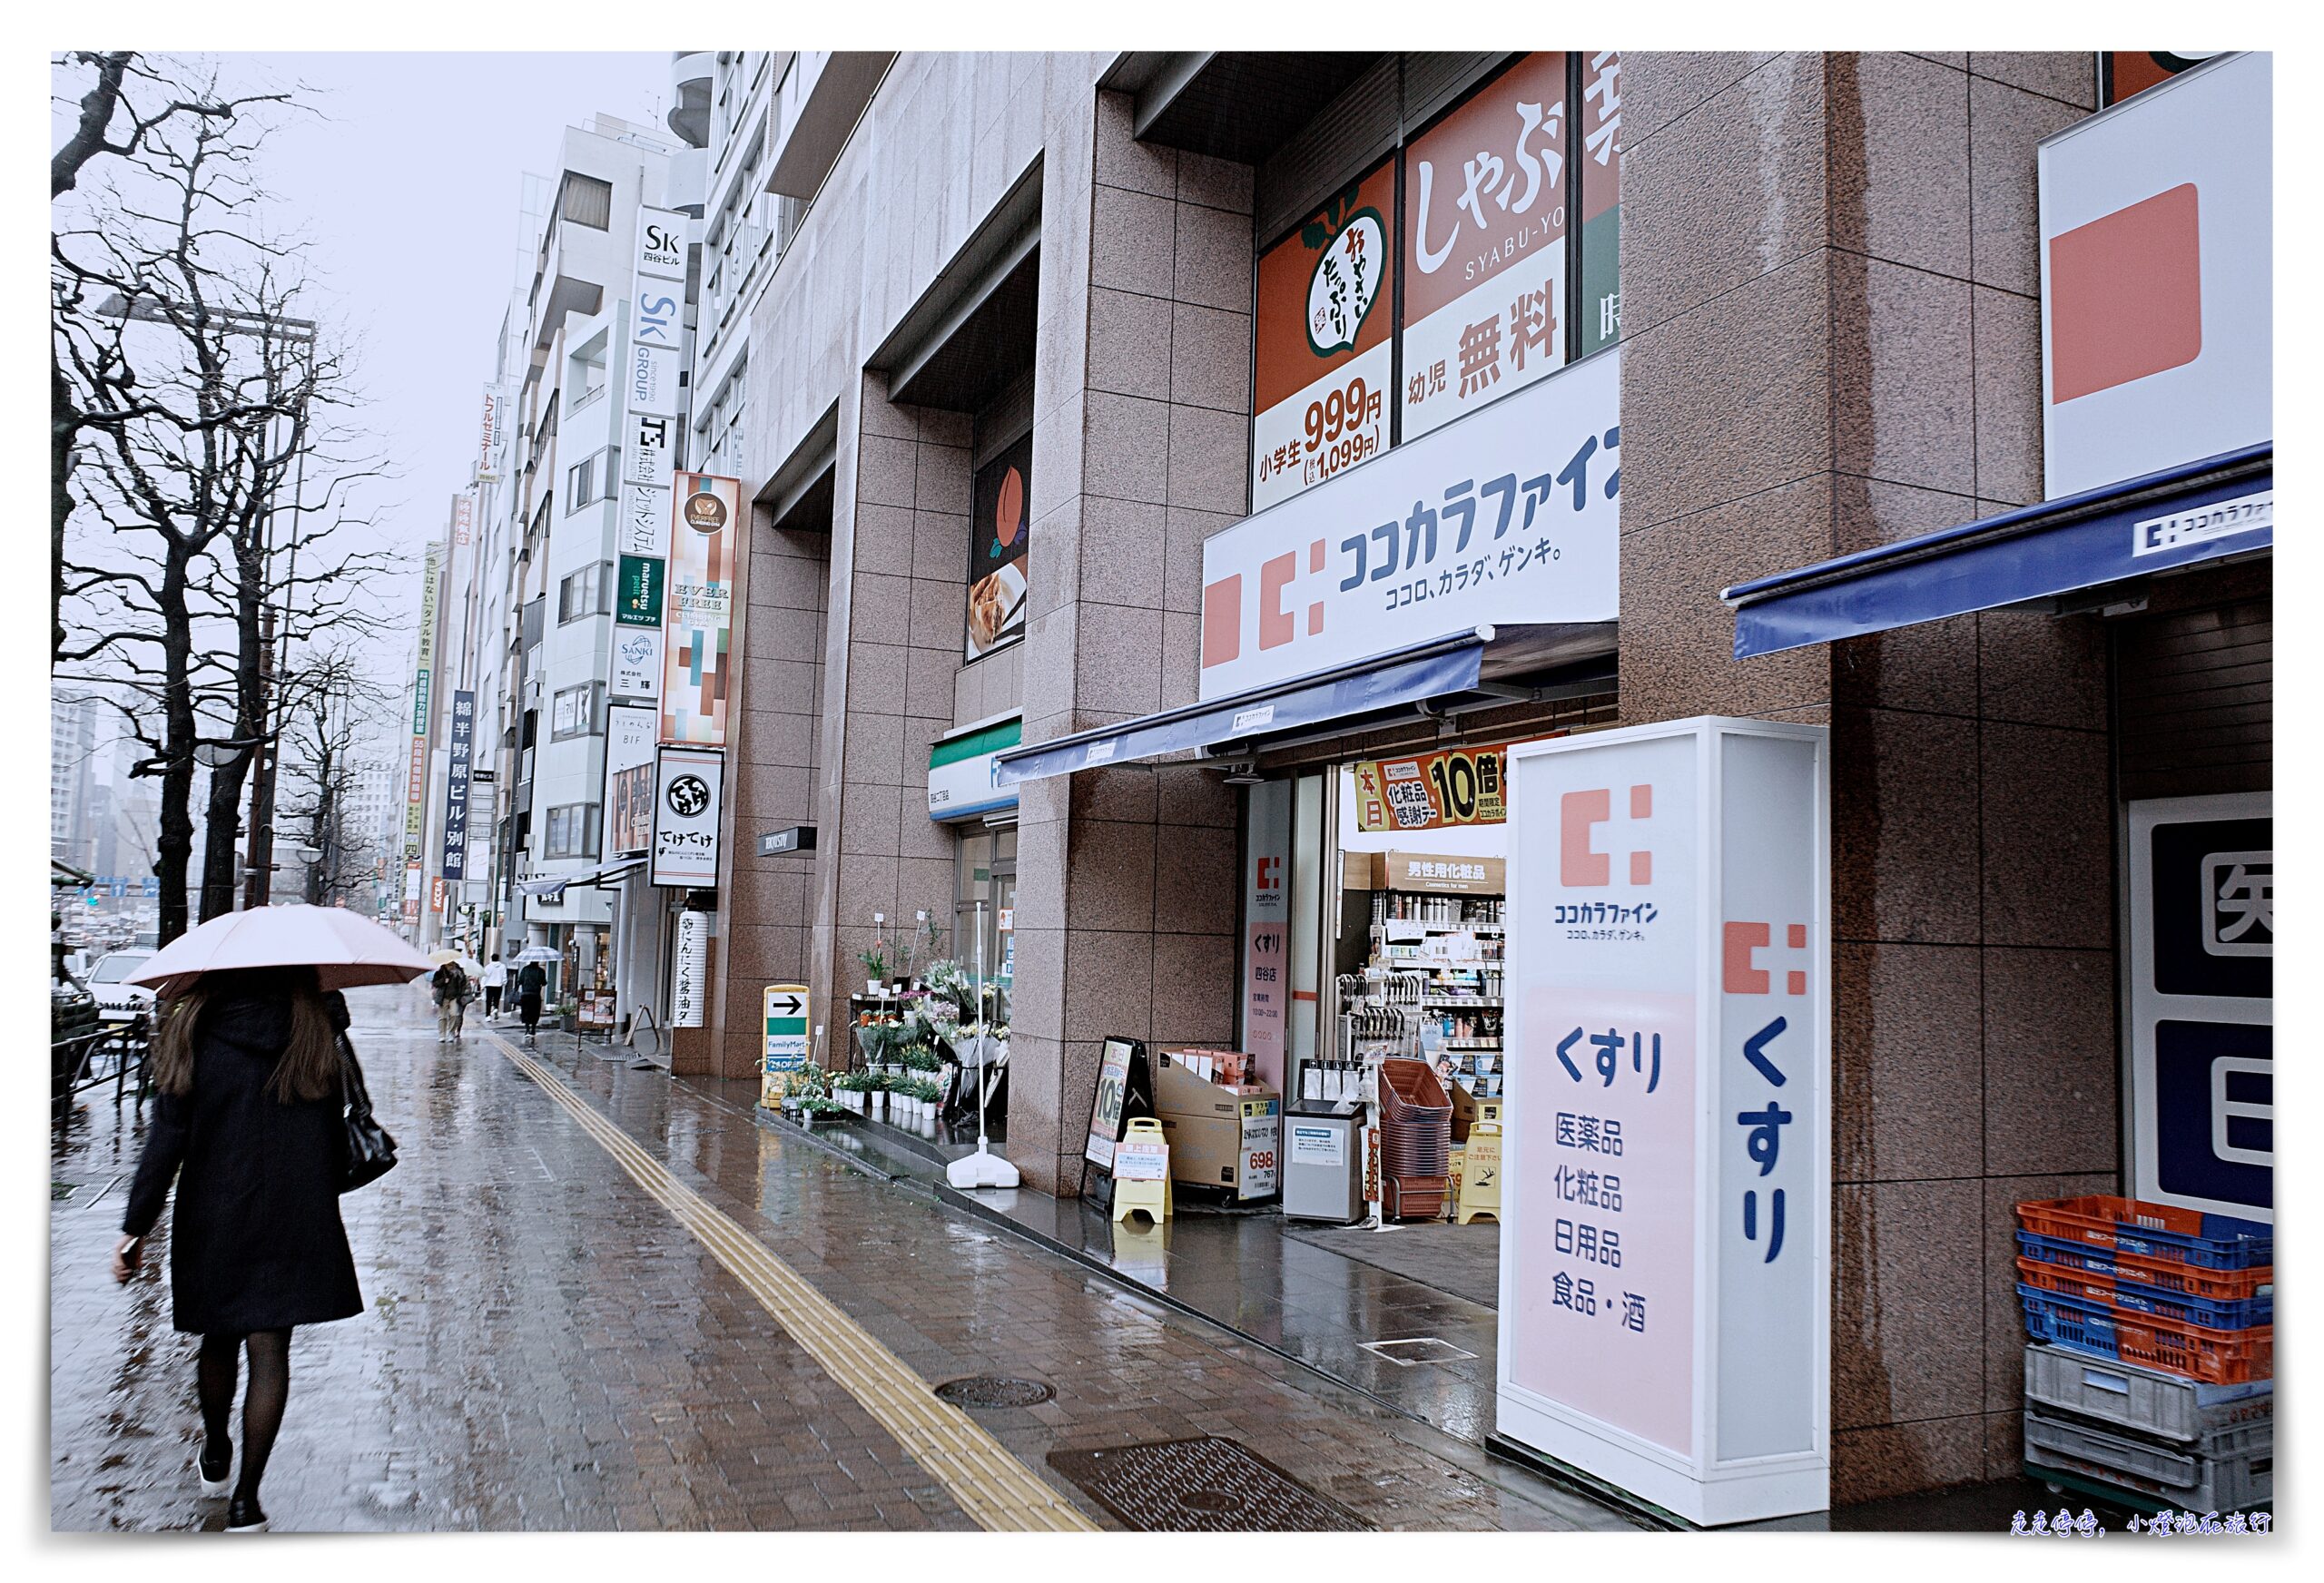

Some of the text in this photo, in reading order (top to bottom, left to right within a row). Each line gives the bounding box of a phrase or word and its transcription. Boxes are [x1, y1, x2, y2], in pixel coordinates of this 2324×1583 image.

[645, 225, 679, 254] SK
[1465, 205, 1564, 280] SYABU-YO
[644, 251, 680, 266] 四谷ビル
[640, 292, 676, 340] SK
[1408, 278, 1557, 406] 幼児 無料
[1259, 377, 1382, 482] 小学生 999円
[639, 562, 651, 610] maruetsu
[675, 584, 729, 599] EVER
[677, 597, 723, 610] FREE
[621, 644, 653, 656] SANKI
[1360, 769, 1383, 826] 本日
[1388, 783, 1427, 805] 化粧品
[1396, 807, 1437, 825] 感謝デー
[659, 831, 714, 848] てけてけ
[1408, 861, 1485, 880] 男性用化粧品
[1555, 902, 1658, 924] ココカラファイン
[1255, 934, 1280, 953] くすり
[1256, 967, 1277, 982] 四谷店
[768, 1041, 805, 1049] FamilyMart
[1555, 1025, 1661, 1094] くすり
[1555, 1111, 1623, 1158] 医薬品
[1738, 1015, 1793, 1264] くすり
[1250, 1150, 1274, 1169] 698
[1554, 1165, 1623, 1213] 化粧品
[1555, 1218, 1621, 1269] 日用品
[1551, 1270, 1646, 1334] 食品・酒
